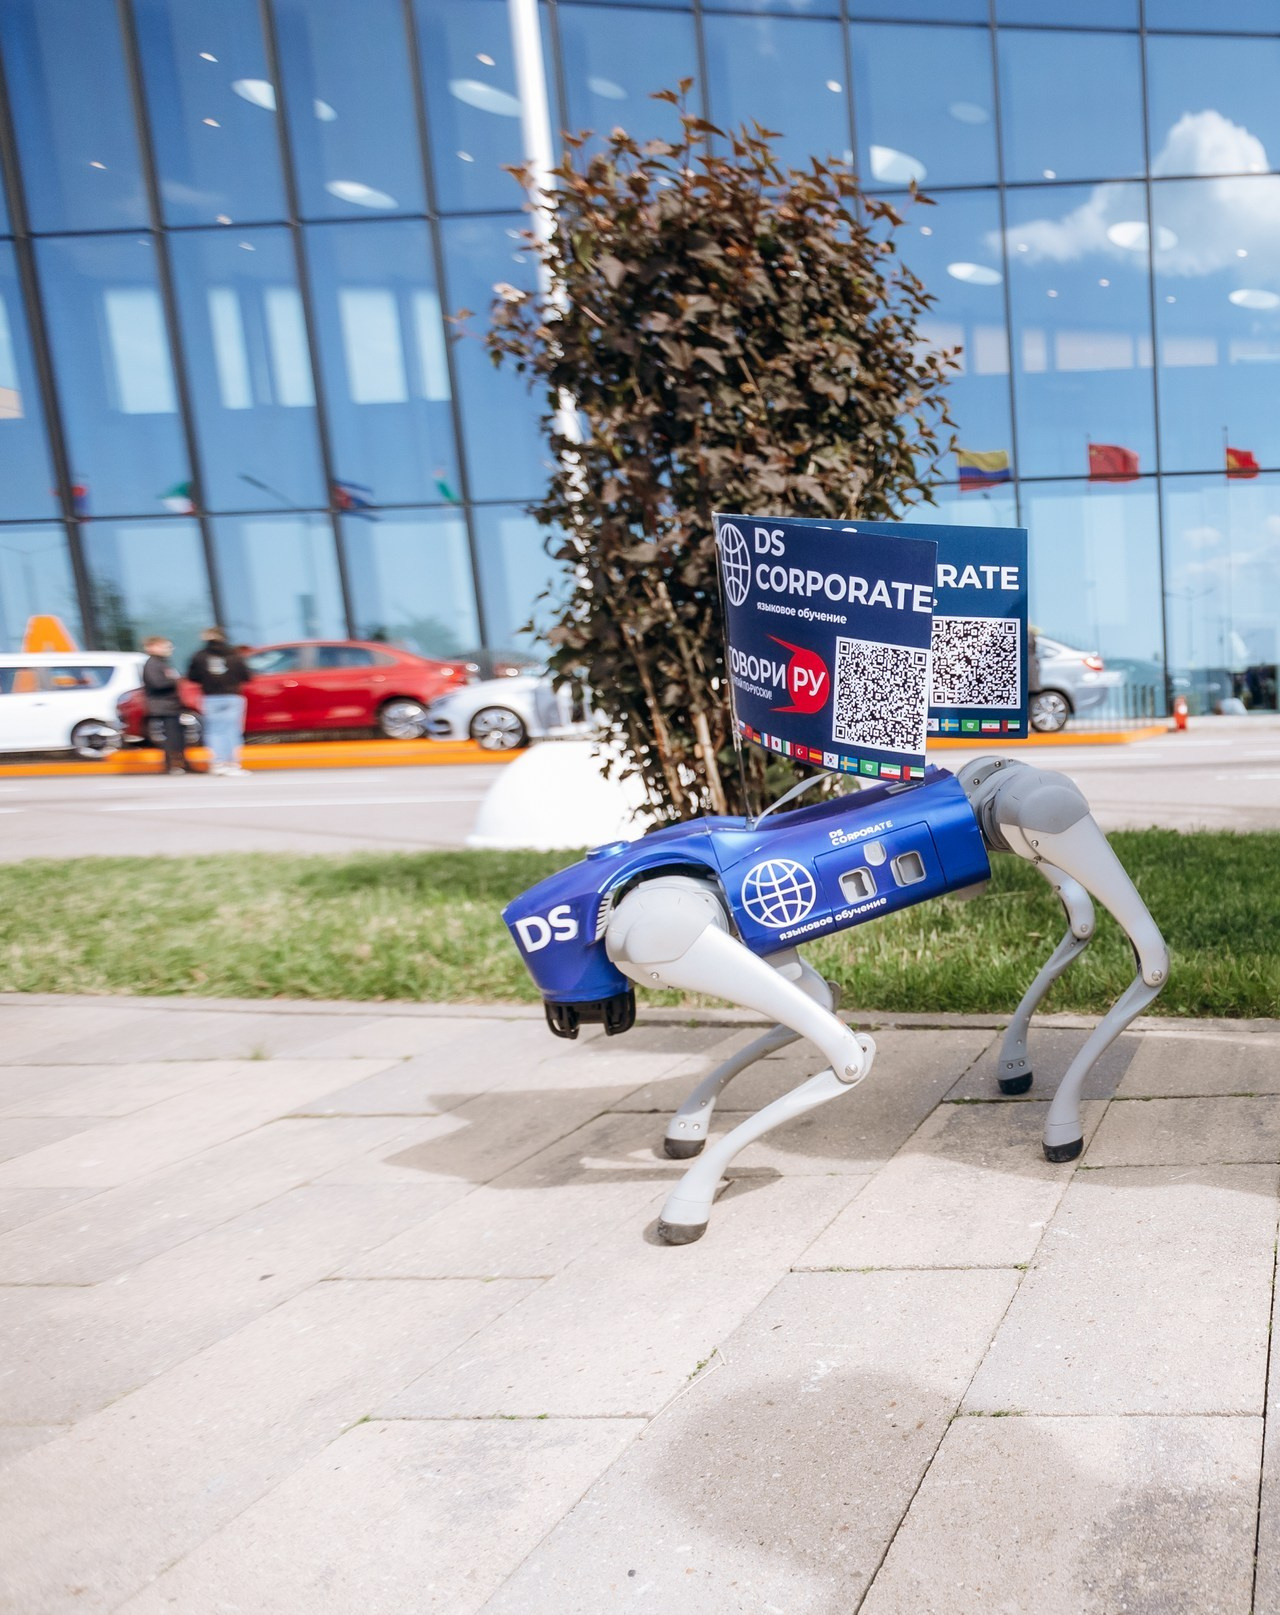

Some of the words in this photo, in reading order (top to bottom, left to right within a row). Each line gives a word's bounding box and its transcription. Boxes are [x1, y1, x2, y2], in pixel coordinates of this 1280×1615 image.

[754, 527, 786, 557] DS
[755, 563, 934, 614] CORPORATE
[937, 564, 1020, 590] RATE
[757, 601, 796, 617] языковое
[797, 608, 848, 625] обучение
[829, 828, 844, 839] DS
[831, 820, 894, 846] CORPORATE
[515, 904, 578, 953] DS
[779, 916, 833, 941] языковое
[835, 897, 887, 921] обучение
